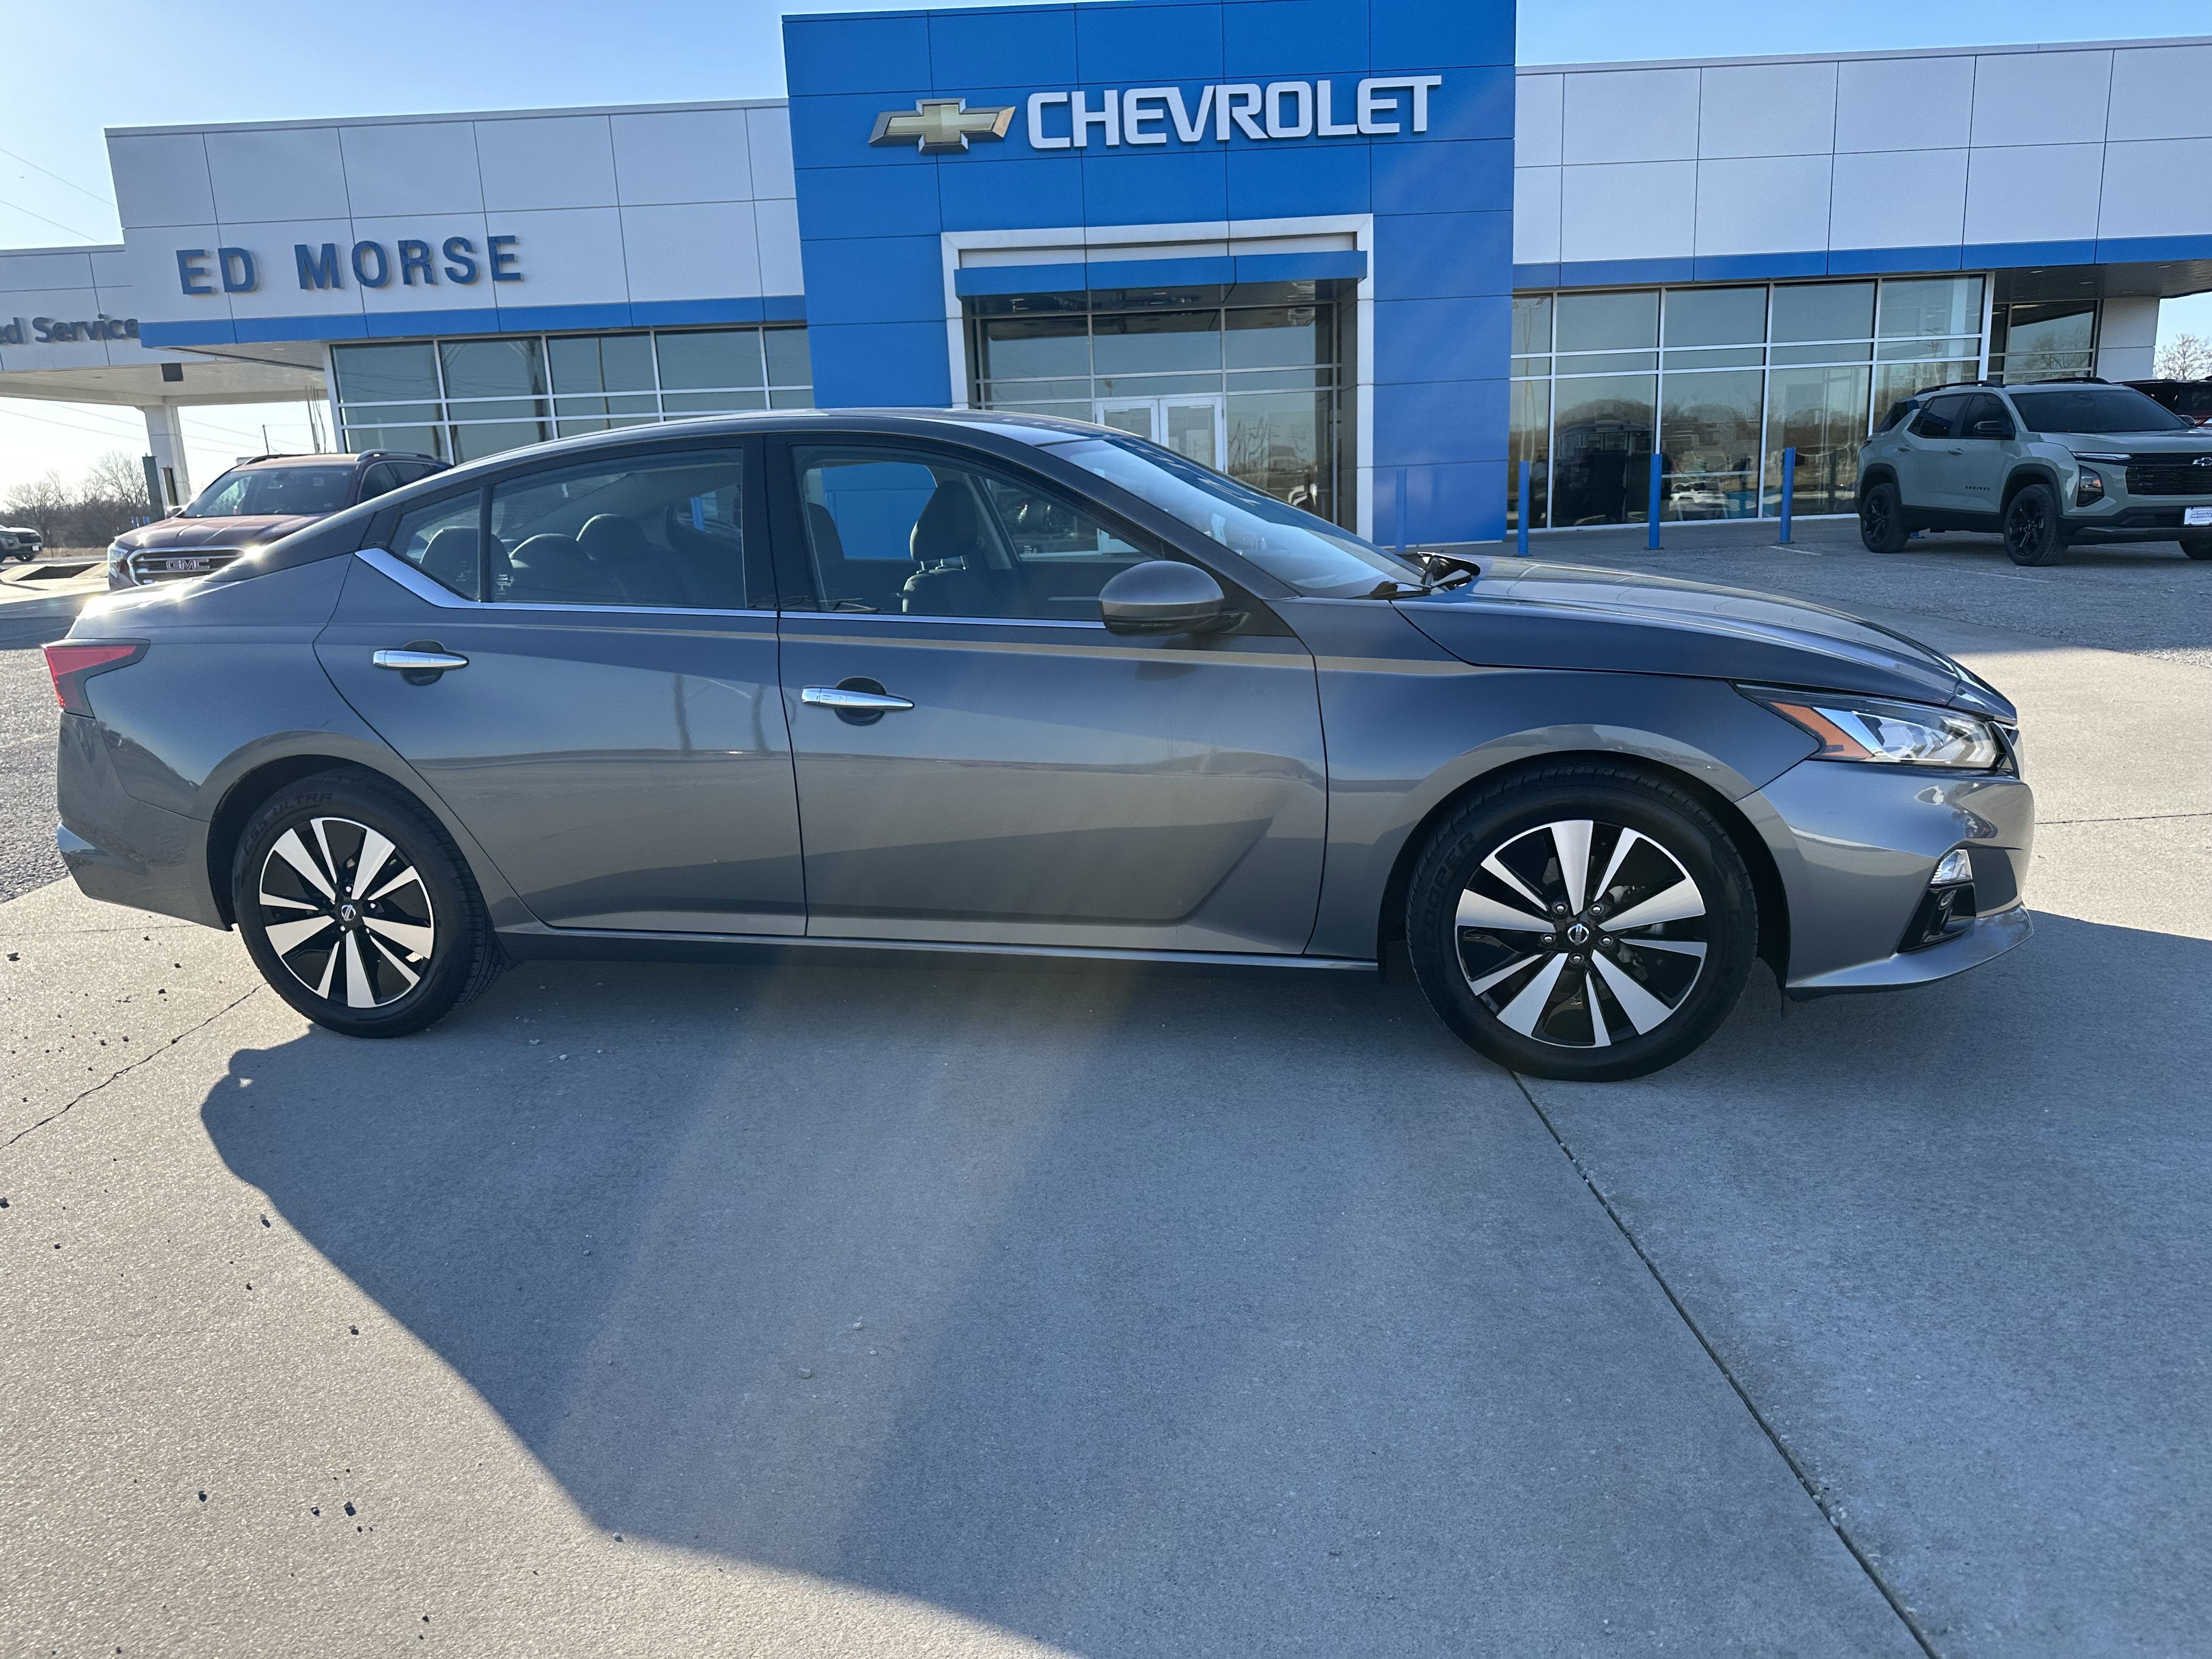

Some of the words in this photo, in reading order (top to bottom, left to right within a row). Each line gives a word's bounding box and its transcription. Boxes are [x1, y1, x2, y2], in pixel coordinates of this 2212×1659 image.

[1028, 75, 1442, 149] CHEVROLET
[176, 247, 258, 295] ED
[294, 235, 523, 290] MORSE
[32, 314, 139, 343] Service
[166, 559, 210, 571] GMC
